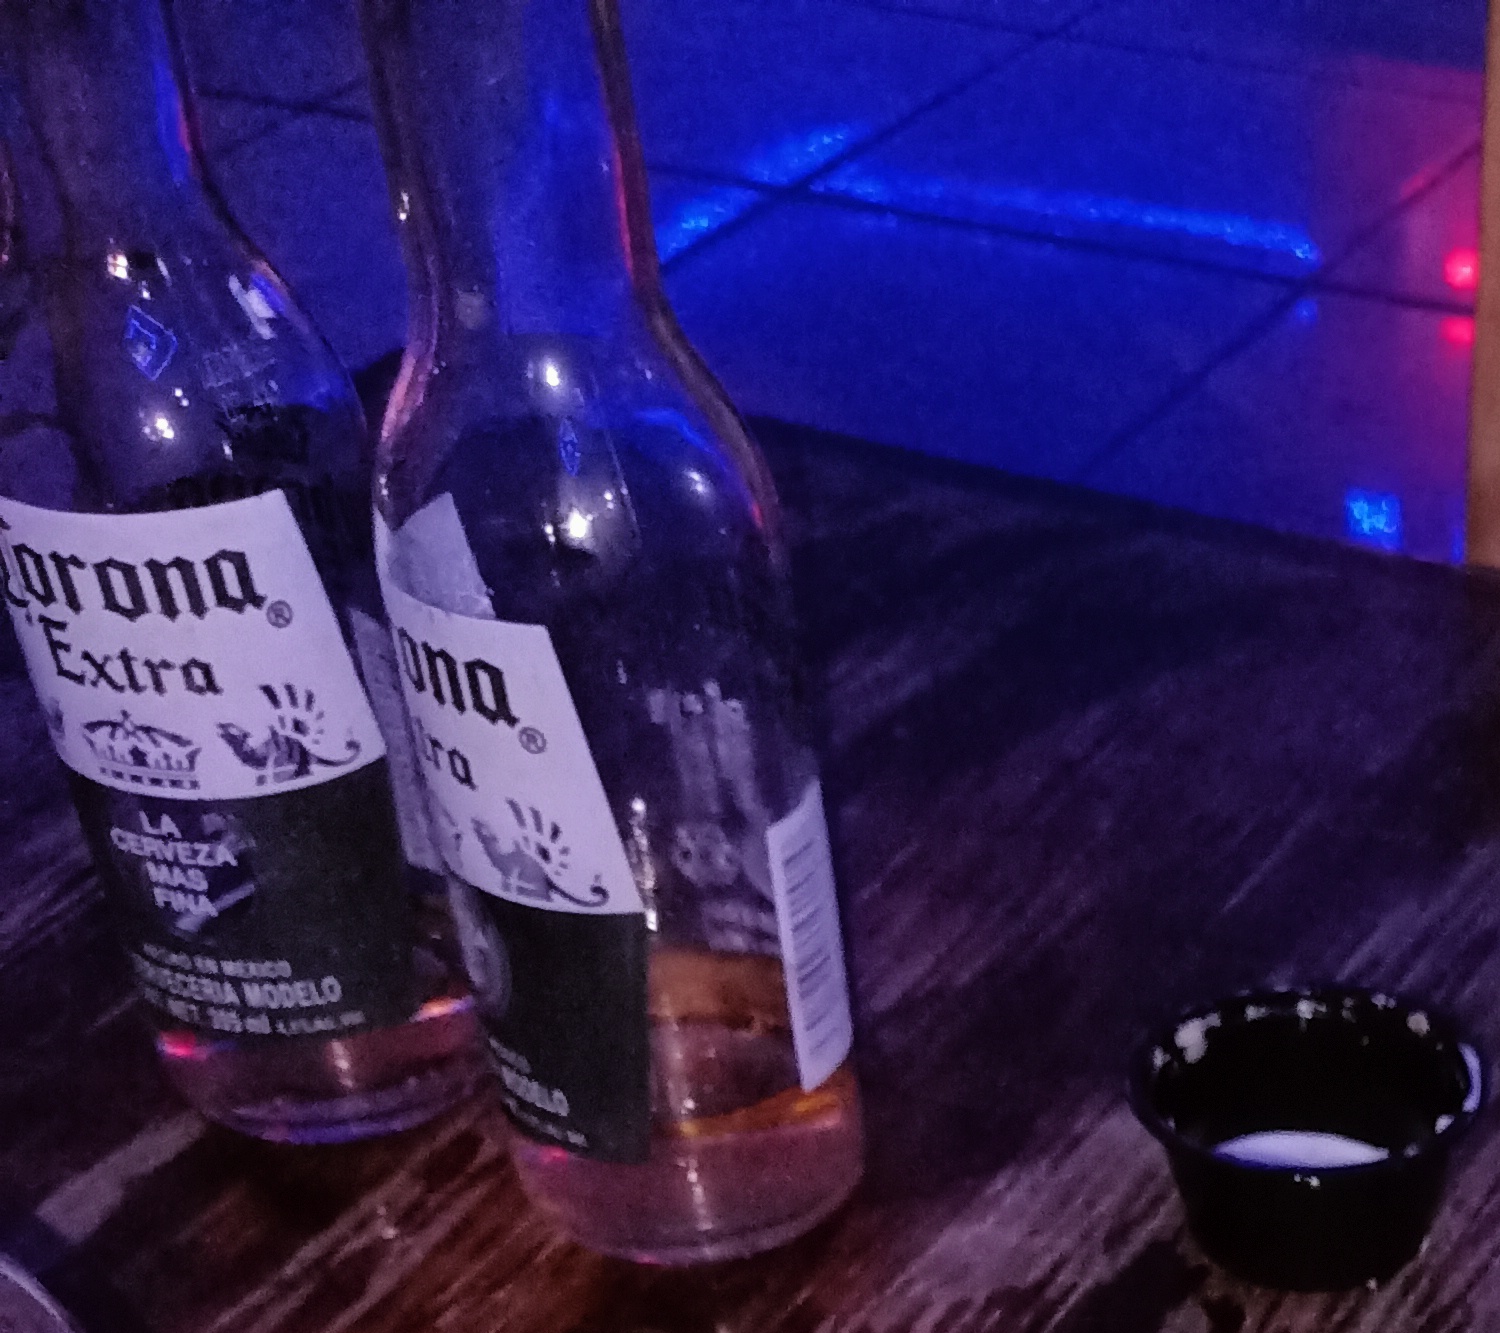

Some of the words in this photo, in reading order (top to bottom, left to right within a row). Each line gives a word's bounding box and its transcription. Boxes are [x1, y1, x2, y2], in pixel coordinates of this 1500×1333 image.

[38, 614, 224, 696] Extra
[138, 810, 182, 838] LA
[109, 827, 239, 868] CERVEZA
